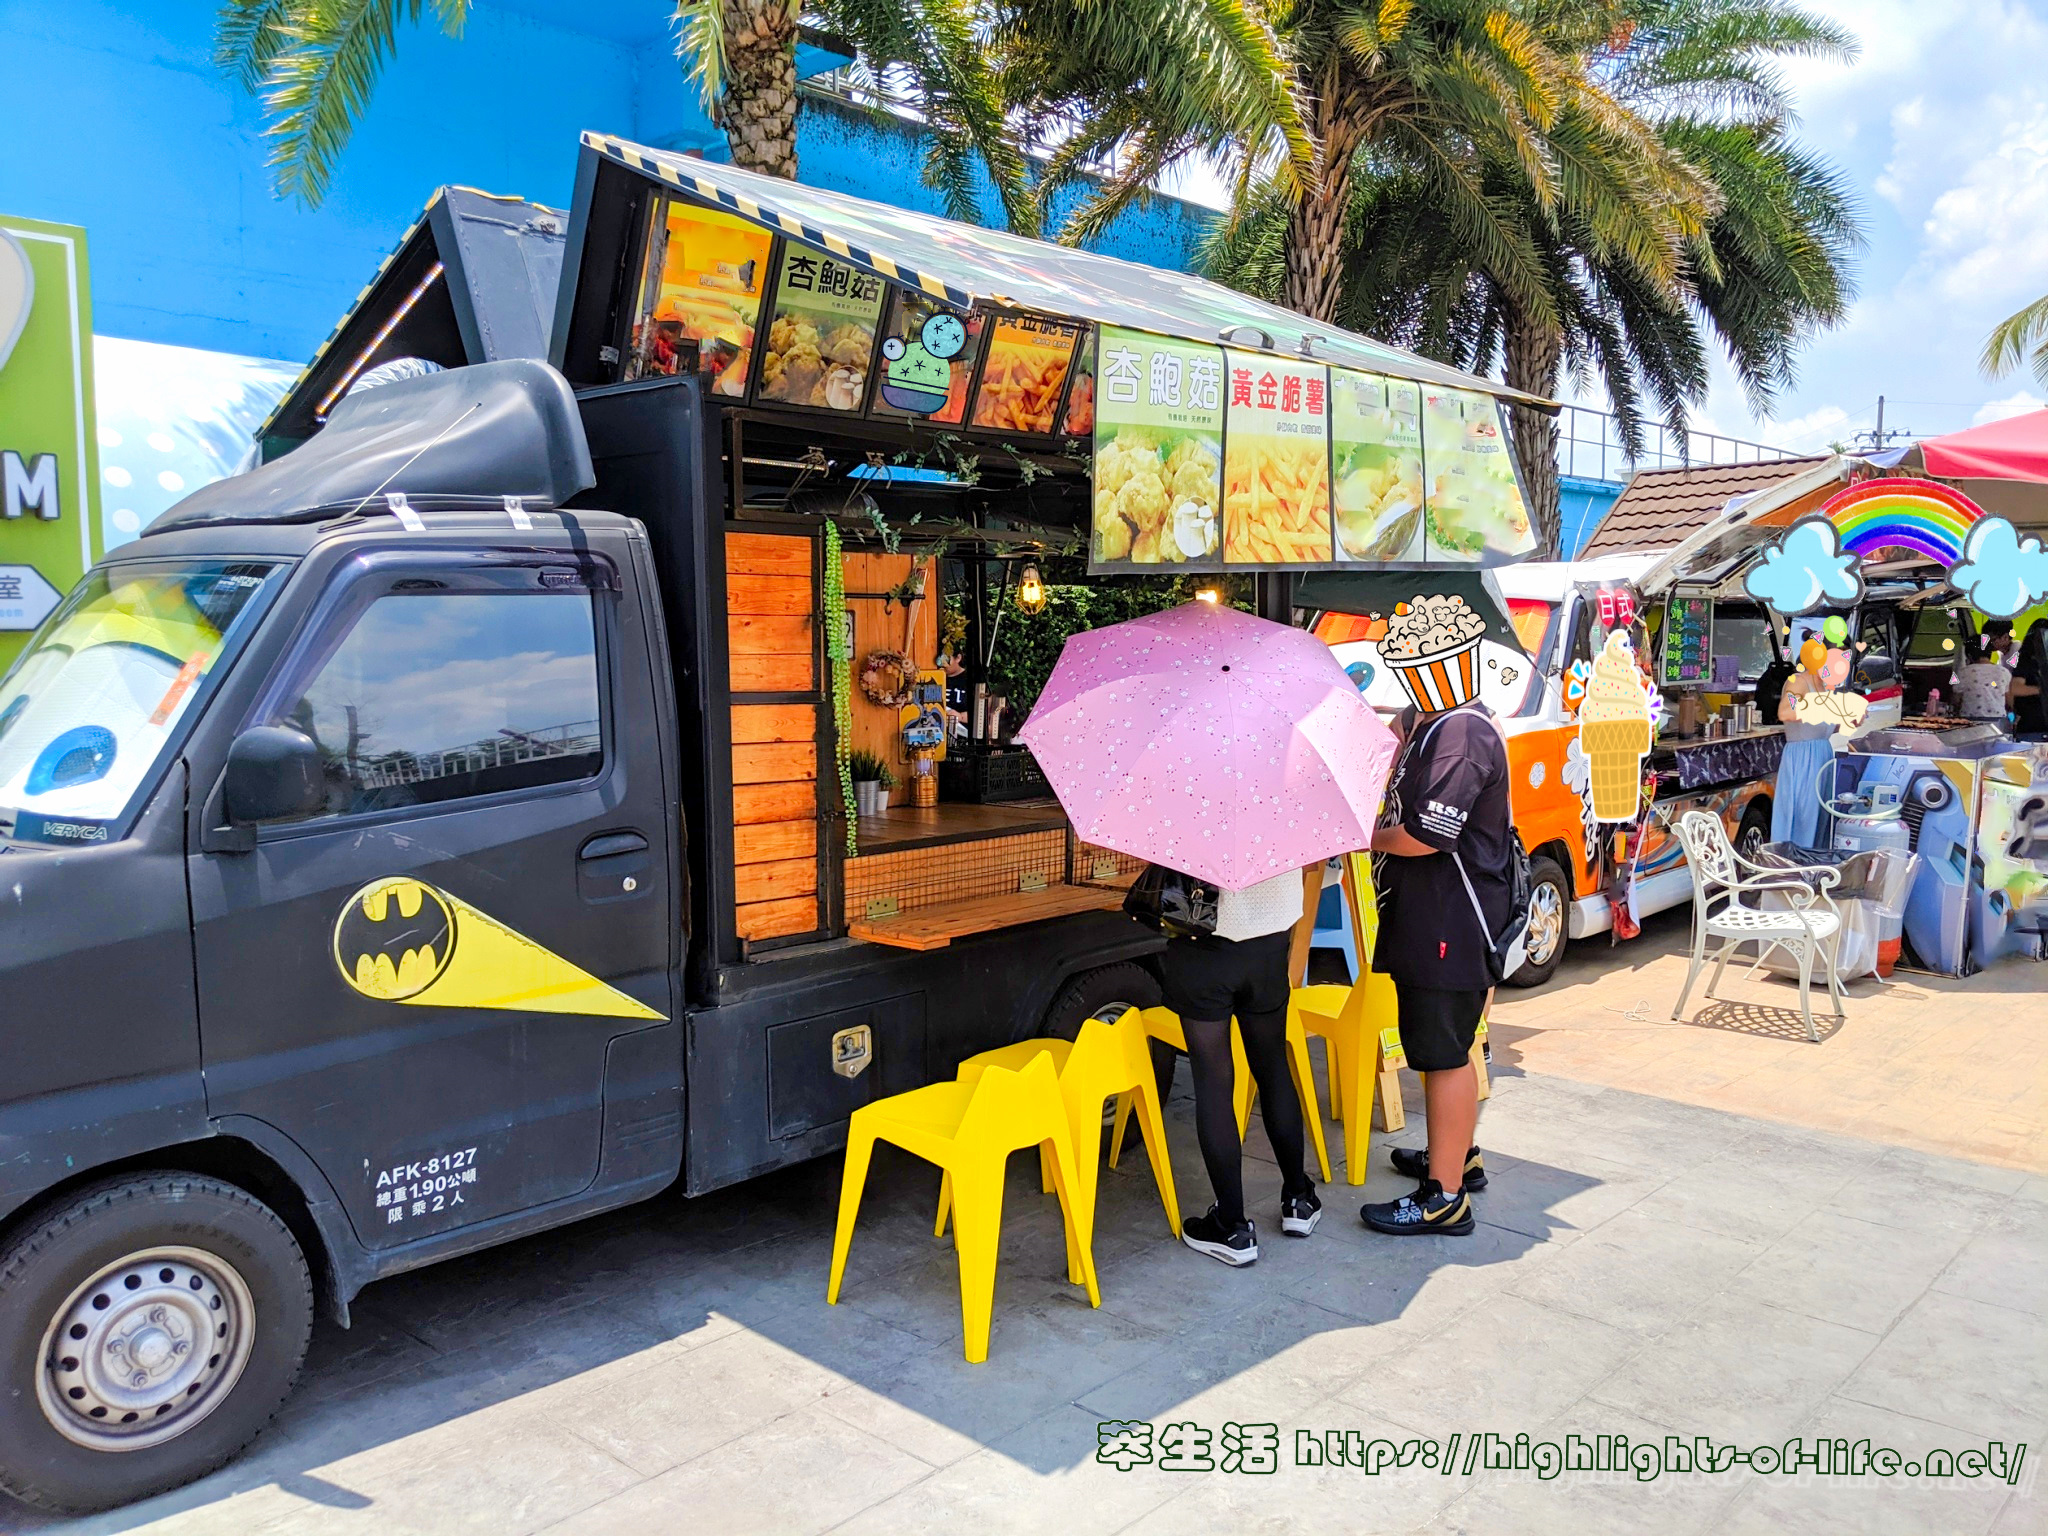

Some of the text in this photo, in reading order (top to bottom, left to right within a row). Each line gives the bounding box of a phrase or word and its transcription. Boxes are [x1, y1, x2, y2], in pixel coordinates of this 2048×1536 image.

[787, 255, 881, 303] 杏鮑菇
[1104, 345, 1220, 410] 杏鮑菇
[1231, 367, 1325, 416] 黃金脆薯
[0, 575, 23, 600] 室
[1598, 593, 1633, 620] 日式
[1427, 800, 1468, 823] RSA
[43, 821, 107, 840] VERYCA
[375, 1147, 478, 1189] AFK-8127
